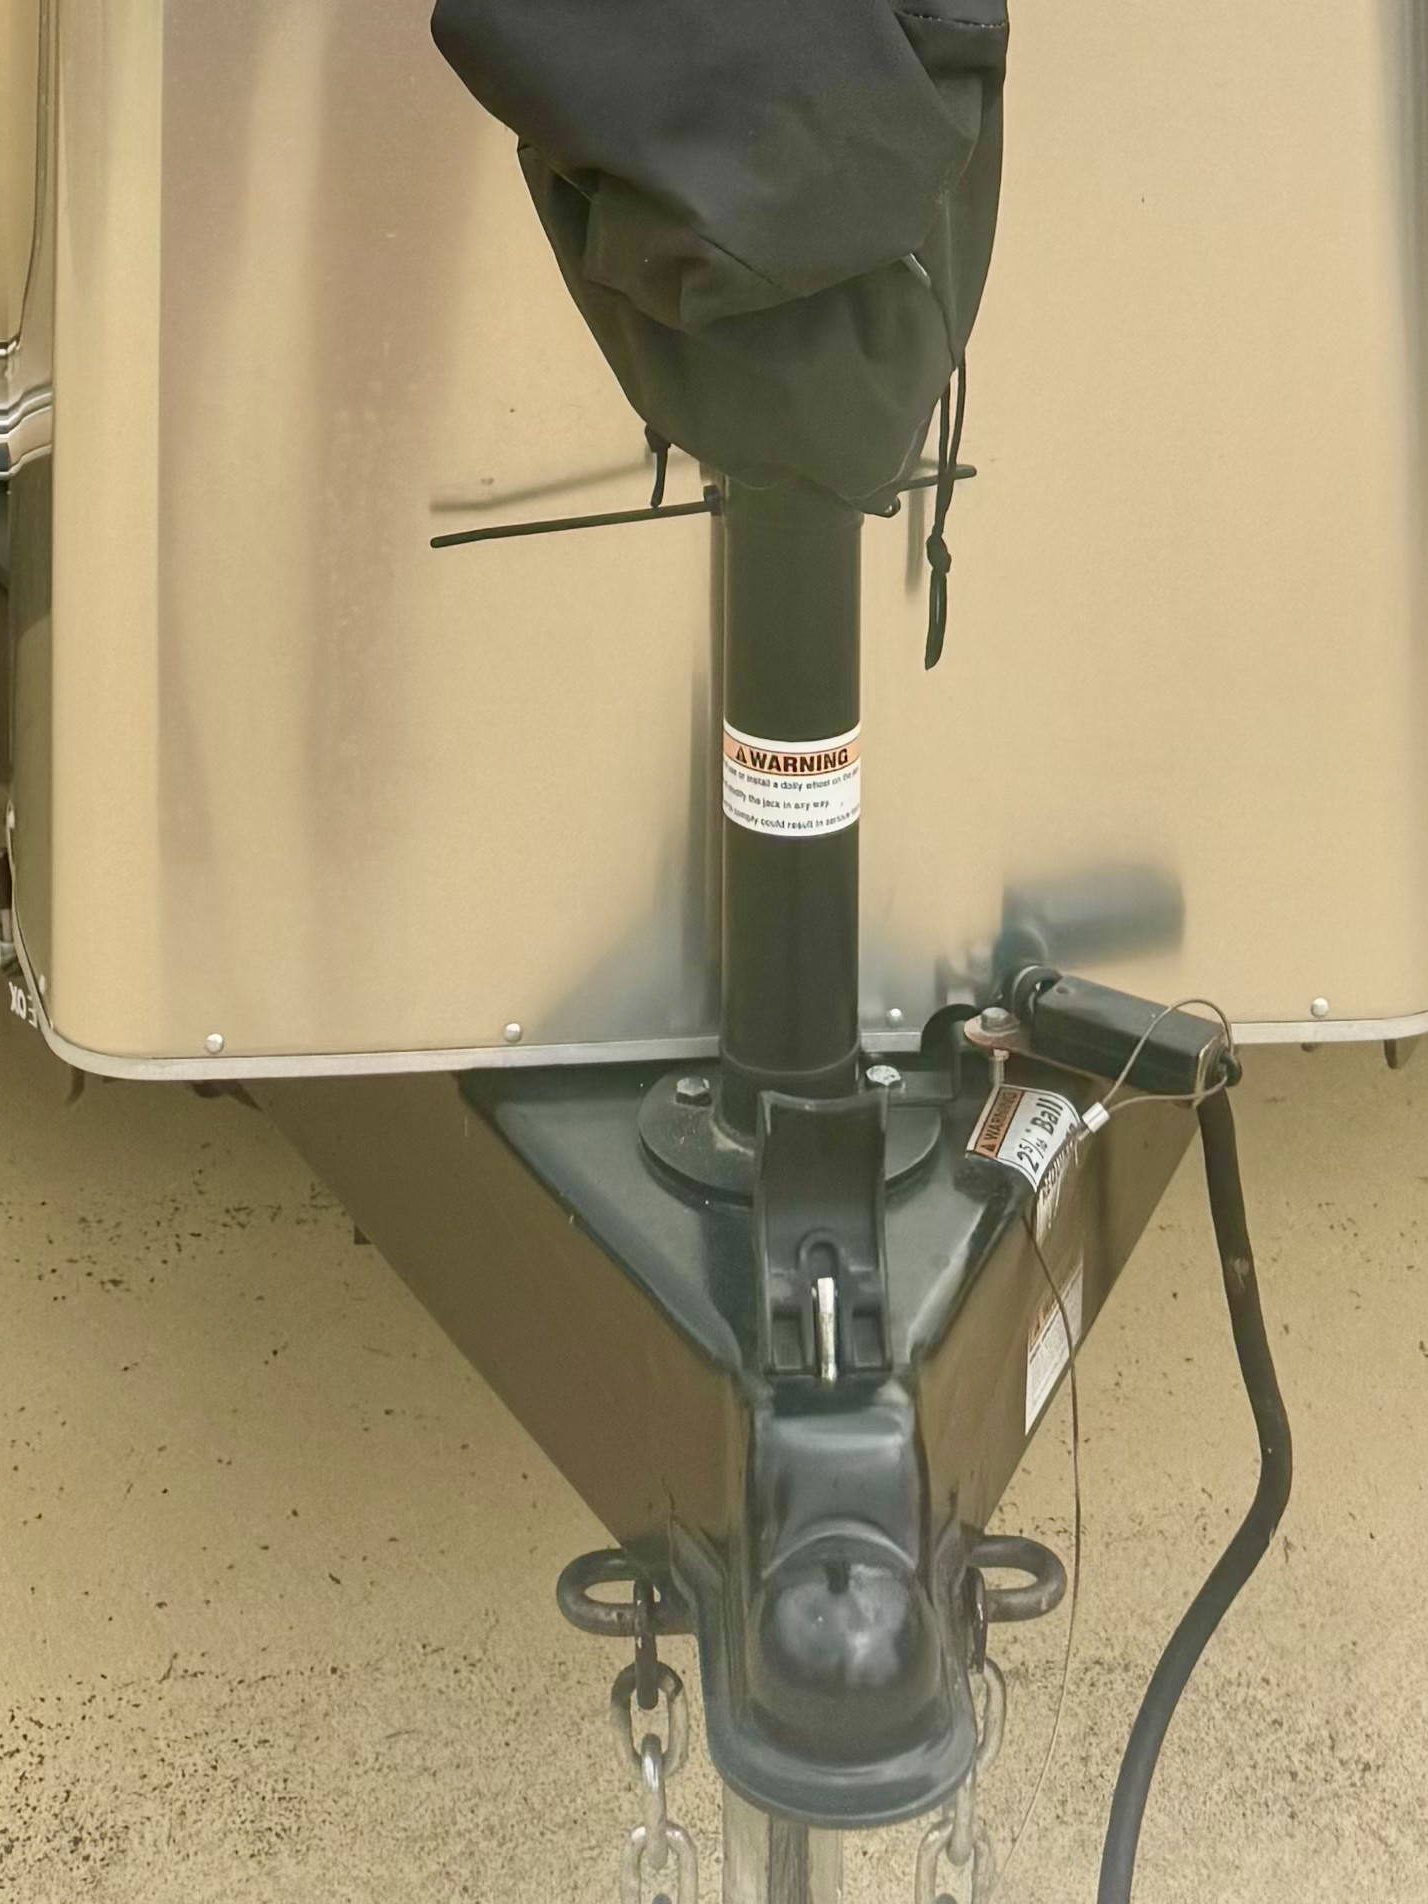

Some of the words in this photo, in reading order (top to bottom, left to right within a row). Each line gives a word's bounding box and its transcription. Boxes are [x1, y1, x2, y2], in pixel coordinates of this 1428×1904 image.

[750, 748, 849, 773] WARNING
[984, 1090, 1018, 1140] WARG
[1029, 1096, 1063, 1135] Ball
